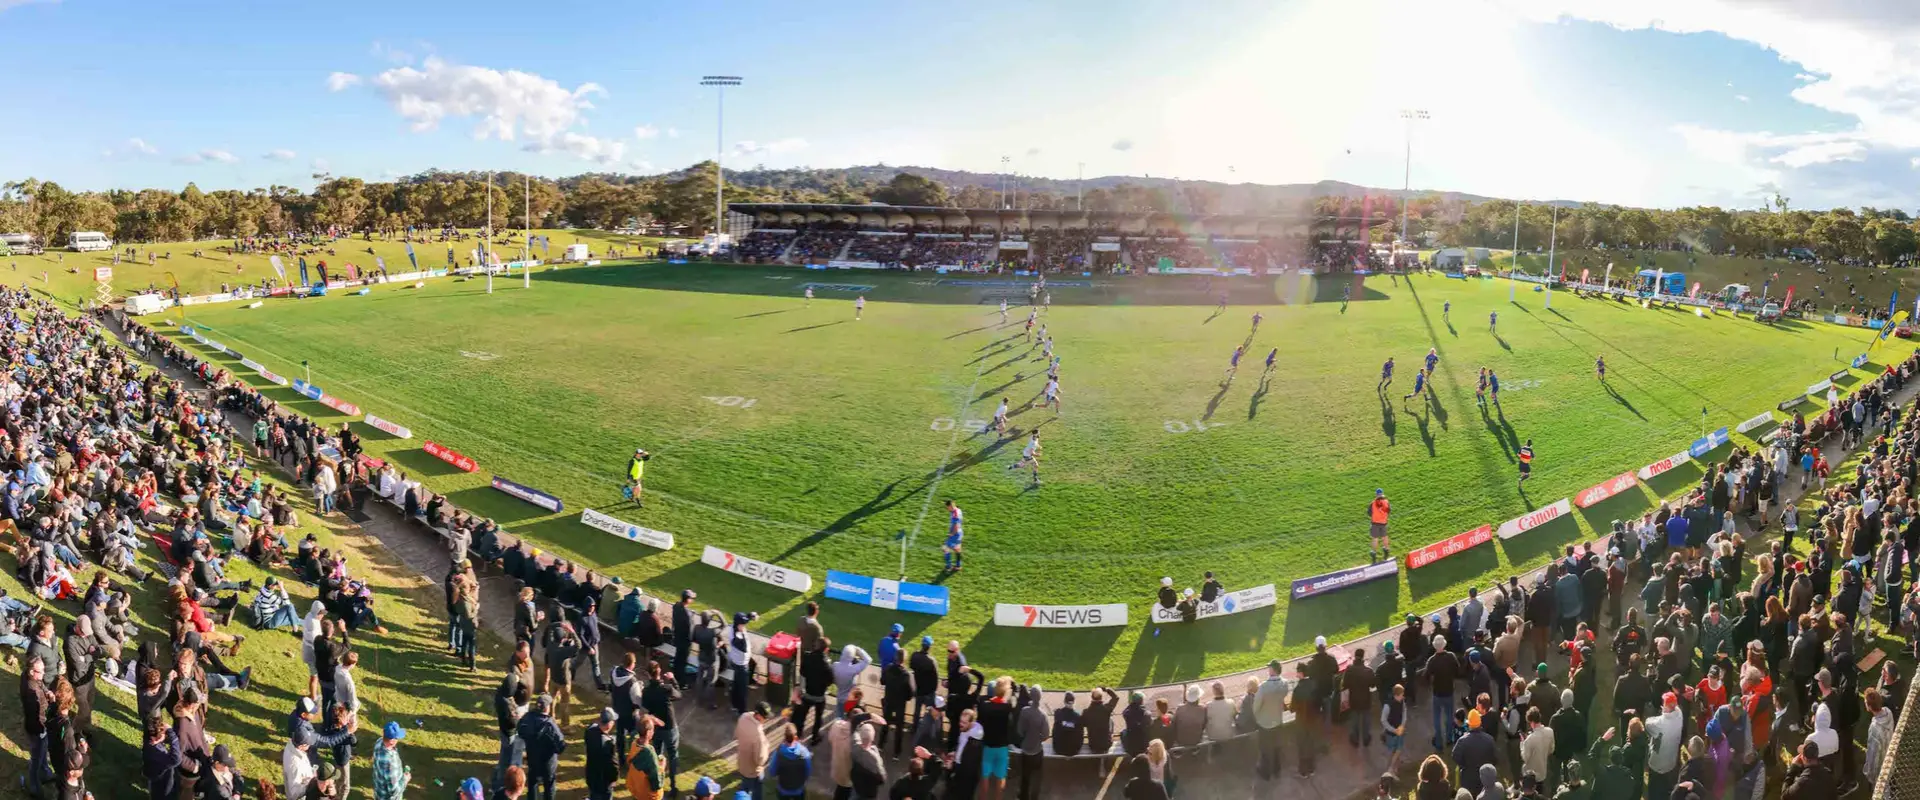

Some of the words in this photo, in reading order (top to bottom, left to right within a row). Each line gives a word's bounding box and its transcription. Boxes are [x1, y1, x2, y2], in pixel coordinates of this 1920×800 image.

[373, 418, 399, 434] Canon
[1649, 459, 1673, 476] nova
[584, 512, 611, 529] Charter
[612, 523, 625, 534] Hall
[1518, 506, 1559, 531] Canon
[1413, 549, 1438, 566] FUJITSU
[1442, 540, 1464, 555] FUJITSU
[1469, 529, 1489, 545] FUJITSU
[1313, 572, 1364, 590] austbrokers
[1200, 601, 1218, 616] Hall
